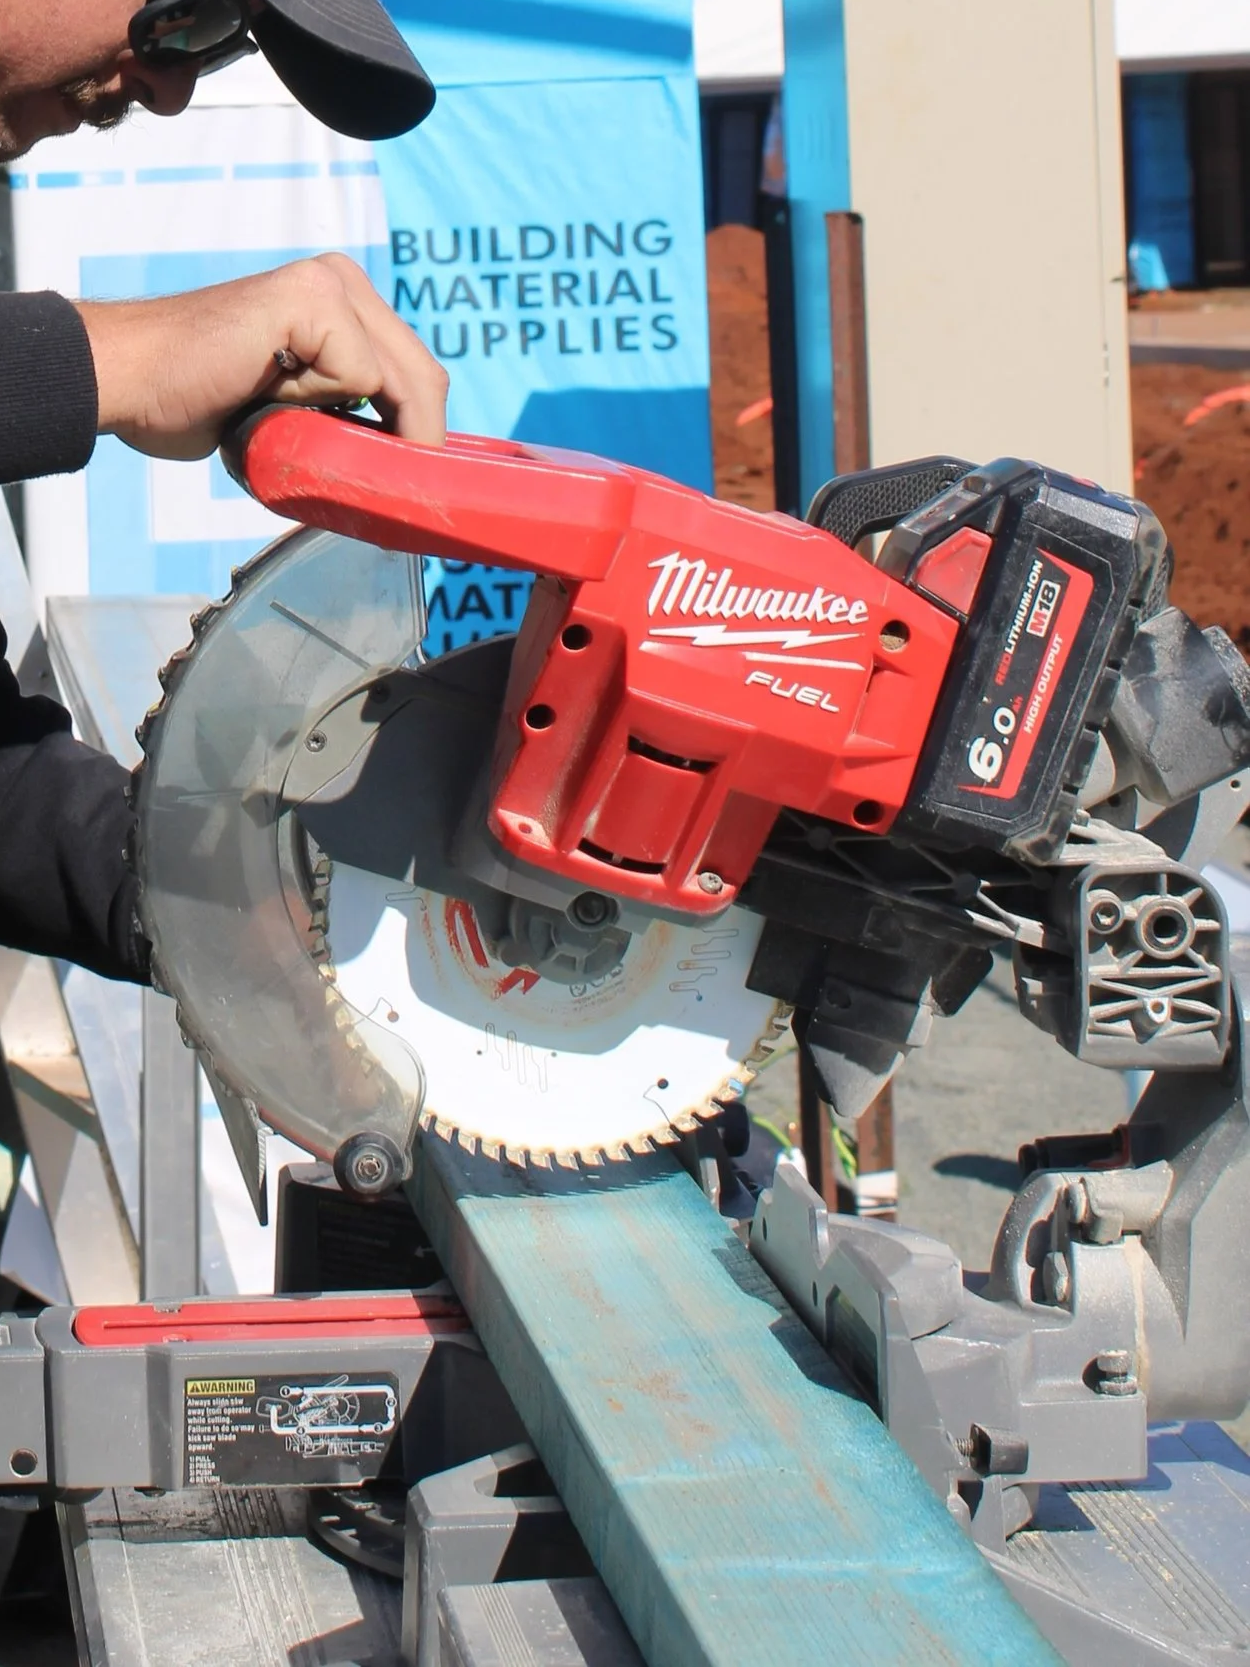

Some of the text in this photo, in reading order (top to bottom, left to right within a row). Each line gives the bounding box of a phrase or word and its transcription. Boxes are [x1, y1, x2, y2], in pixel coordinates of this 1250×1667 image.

[390, 219, 673, 266] BUILDING
[392, 267, 673, 313] MATERIAL
[405, 313, 679, 360] UPPLIES
[648, 551, 869, 625] Milwaukee
[1028, 582, 1059, 636] M18
[744, 671, 840, 713] FUEL
[1023, 633, 1064, 734] HIGH OUTPUT
[968, 706, 1016, 783] 6.0
[187, 1398, 210, 1407] Always
[200, 1381, 254, 1393] WARNING
[187, 1425, 211, 1433] Failure
[240, 1424, 255, 1433] may
[223, 1406, 252, 1415] operator
[187, 1434, 202, 1442] kick
[218, 1433, 237, 1441] blade
